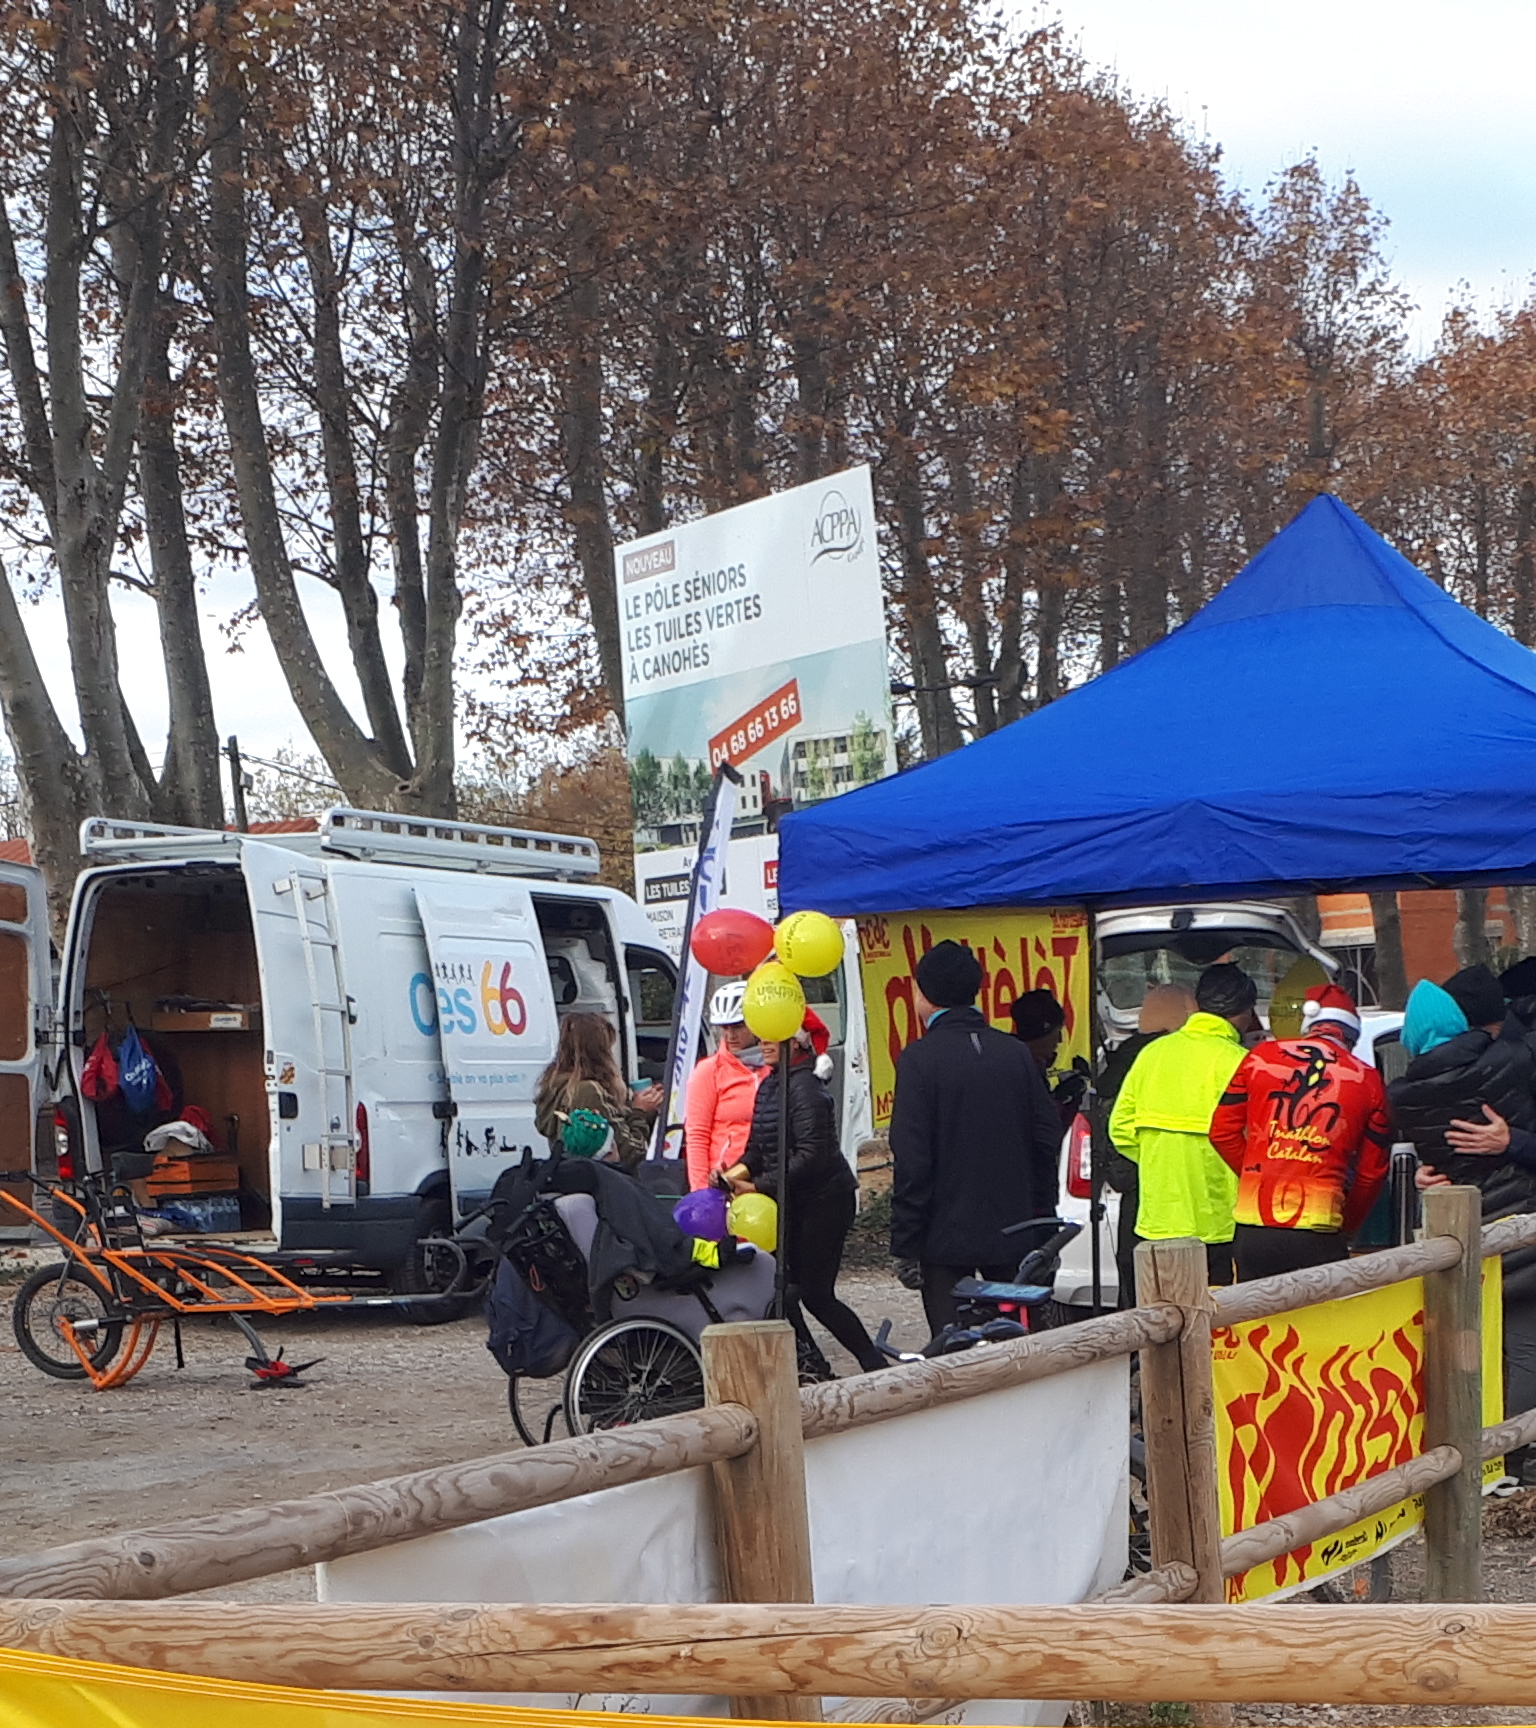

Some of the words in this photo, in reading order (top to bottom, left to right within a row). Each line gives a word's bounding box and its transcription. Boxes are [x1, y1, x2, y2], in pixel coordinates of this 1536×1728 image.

[811, 507, 858, 547] ACPPA
[626, 547, 673, 576] NOUVEAU
[625, 595, 642, 620] LE
[645, 582, 681, 615] PÔLE
[684, 563, 747, 603] SÉNIORS
[627, 625, 652, 653] LES
[654, 611, 702, 645] TUILES
[705, 594, 762, 631] VERTES
[630, 655, 640, 684] À
[642, 639, 710, 681] CANOHÈS
[712, 741, 730, 768] 04
[730, 730, 747, 755] 68
[747, 716, 765, 743] 66
[764, 706, 779, 730] 13
[780, 693, 797, 720] 66
[646, 884, 661, 900] LES
[661, 880, 690, 897] TUILES
[1267, 1141, 1323, 1164] Catalan
[1269, 1120, 1331, 1146] Triathlon
